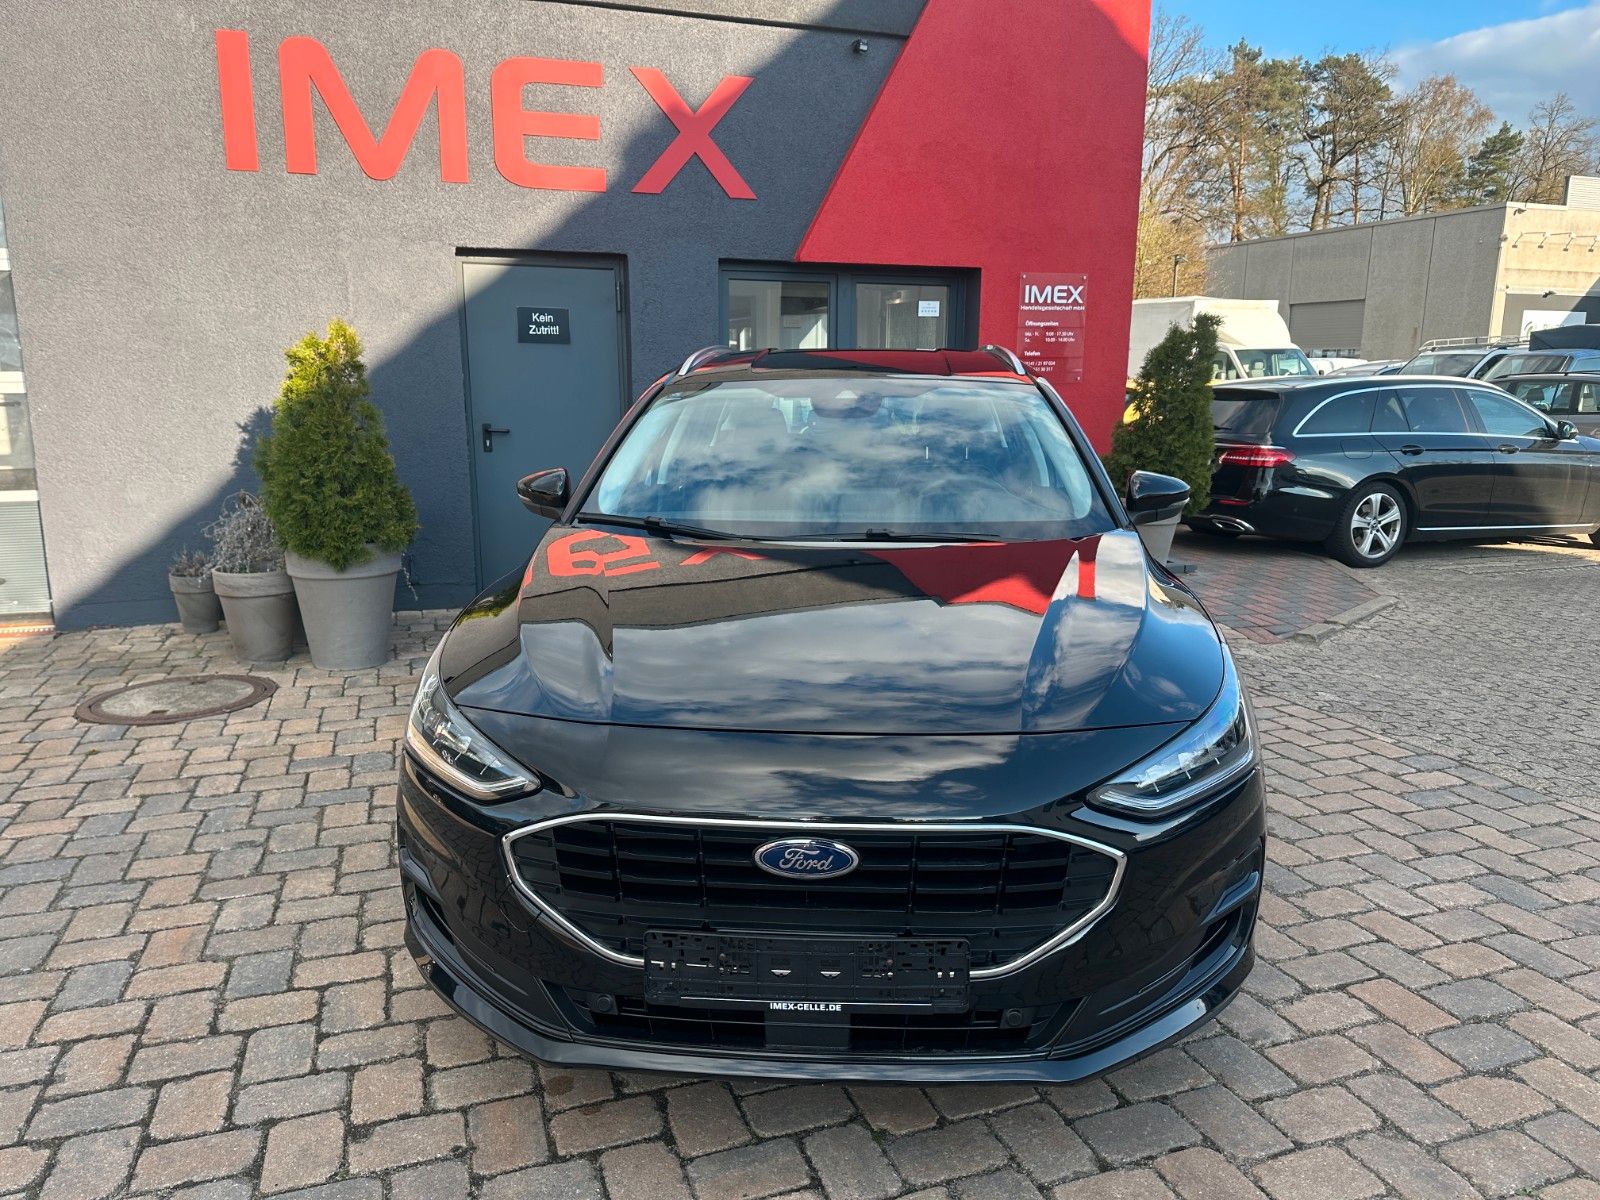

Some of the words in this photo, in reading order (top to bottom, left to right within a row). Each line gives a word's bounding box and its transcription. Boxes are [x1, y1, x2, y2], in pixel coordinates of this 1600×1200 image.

[215, 29, 758, 200] IMEX
[1024, 285, 1084, 303] IMEX
[532, 312, 554, 322] Kein
[529, 325, 559, 335] Zutritt!
[779, 848, 834, 871] Ford
[769, 1001, 842, 1011] IMEX-CELLE.DE
